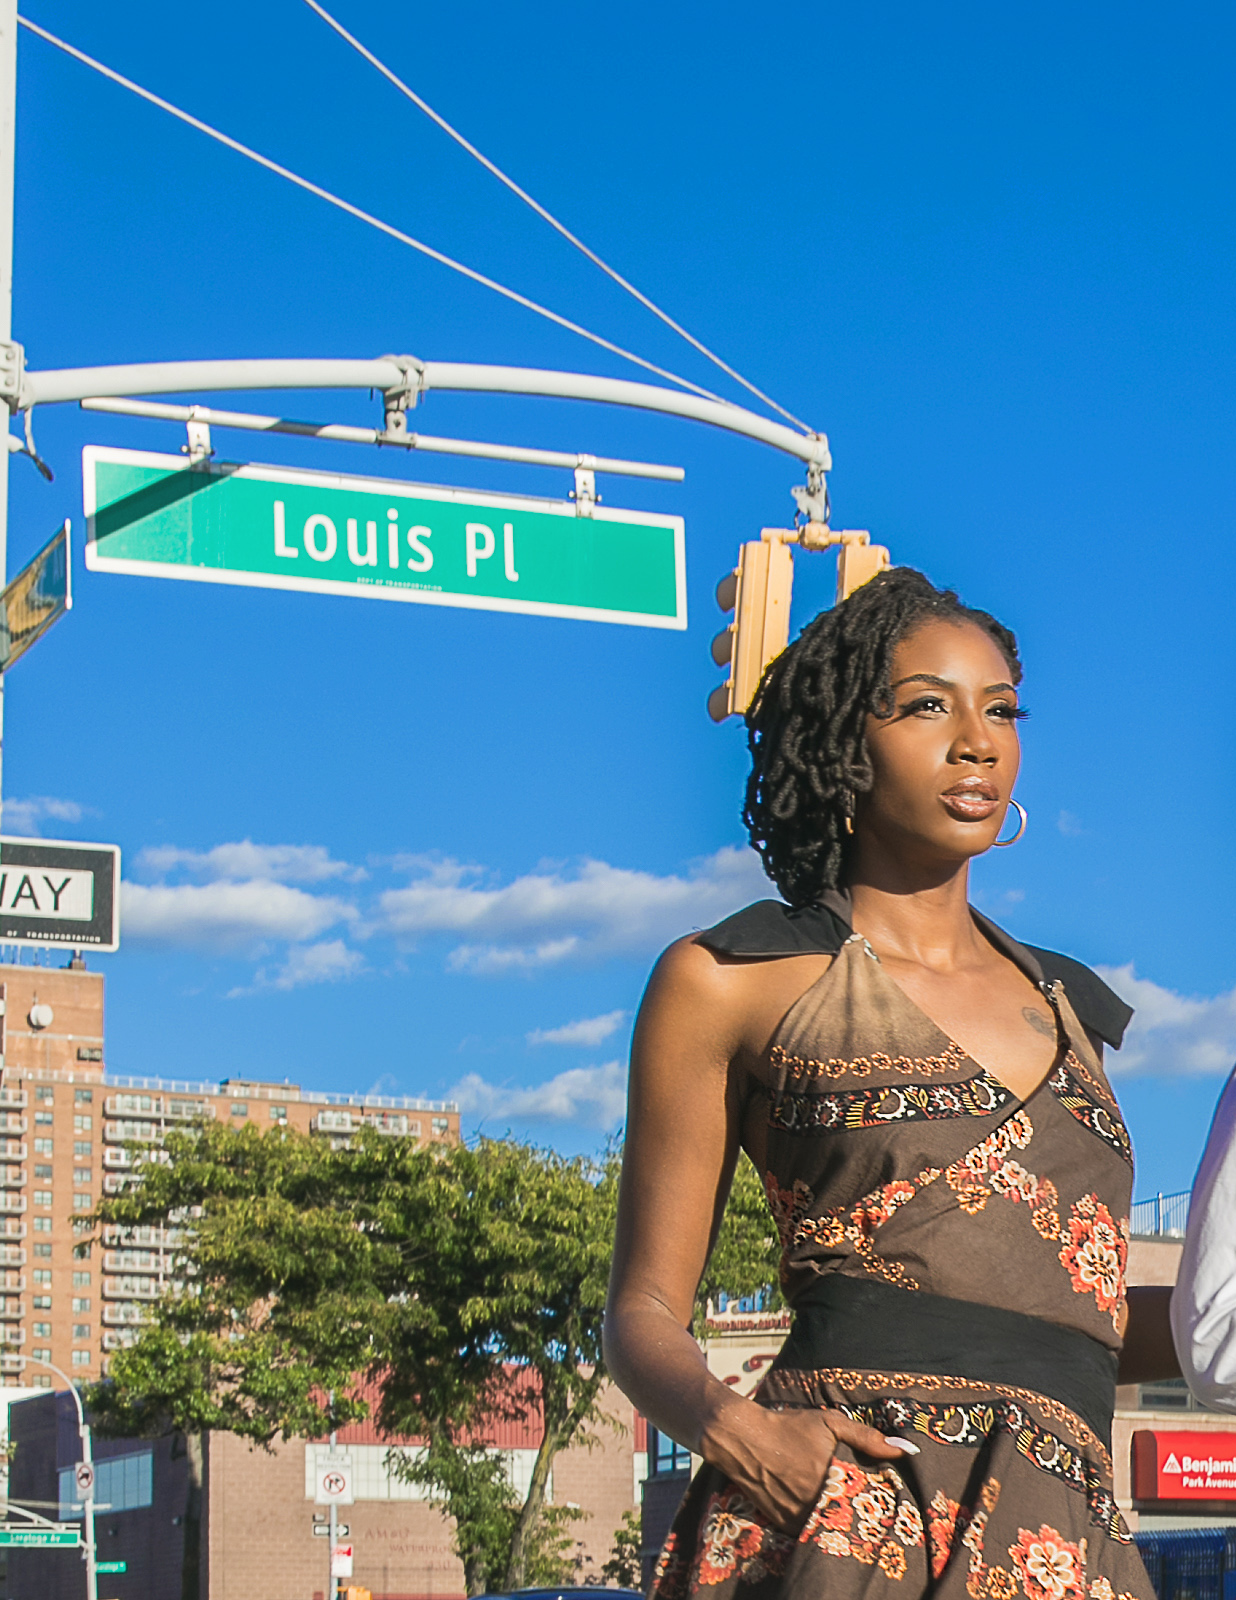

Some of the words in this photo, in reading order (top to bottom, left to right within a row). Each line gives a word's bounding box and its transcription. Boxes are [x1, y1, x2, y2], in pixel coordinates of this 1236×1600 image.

[273, 500, 434, 573] Louis
[465, 522, 519, 582] Pl
[0, 873, 72, 912] AY
[1182, 1476, 1204, 1488] Park
